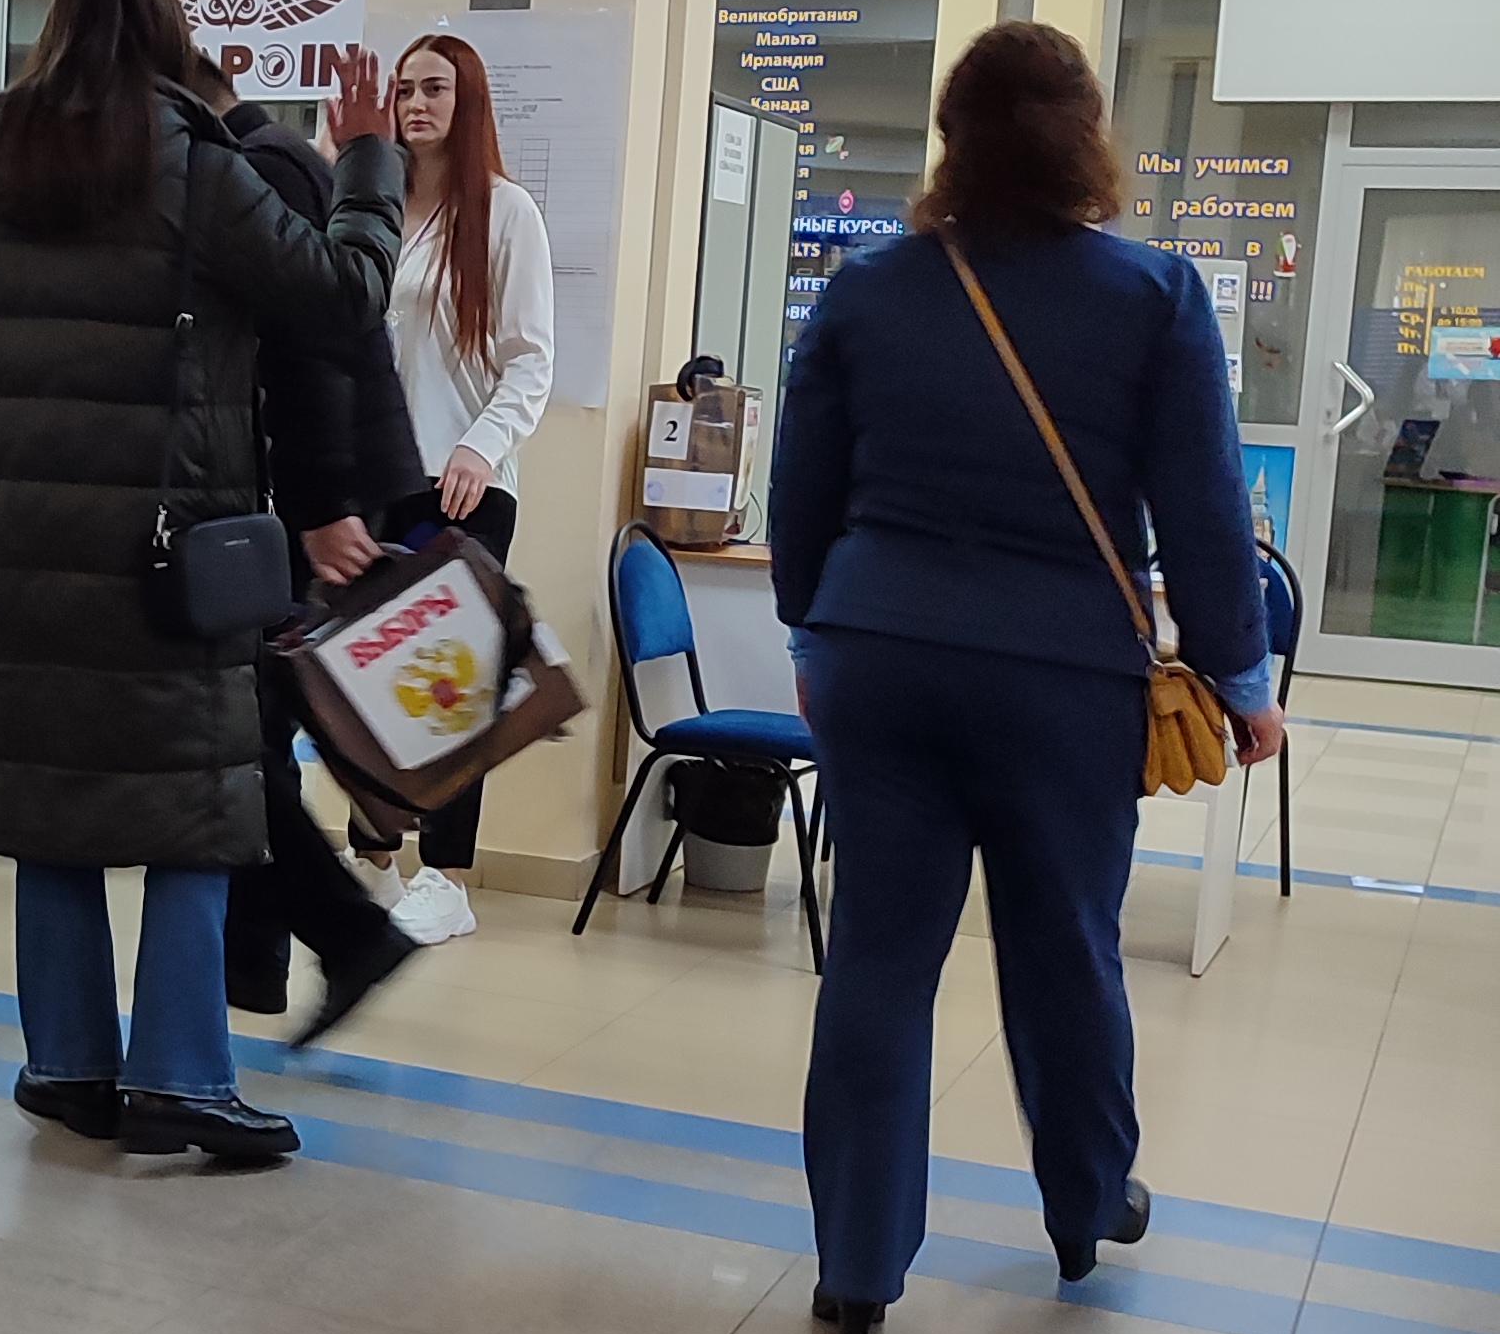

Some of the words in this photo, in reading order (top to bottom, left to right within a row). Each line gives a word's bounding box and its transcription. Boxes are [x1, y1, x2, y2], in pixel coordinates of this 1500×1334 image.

[718, 8, 859, 25] Великобритания
[756, 32, 817, 47] Мальта
[741, 52, 824, 70] Ирландия
[761, 77, 800, 92] США
[750, 97, 810, 114] Канада
[1138, 153, 1182, 174] Мы
[1195, 158, 1290, 178] учимся
[1136, 200, 1151, 215] и
[1171, 195, 1296, 220] работаем
[839, 219, 904, 235] КУРСЫ:
[791, 242, 821, 258] LTS
[1246, 241, 1262, 256] в
[663, 420, 679, 443] 2
